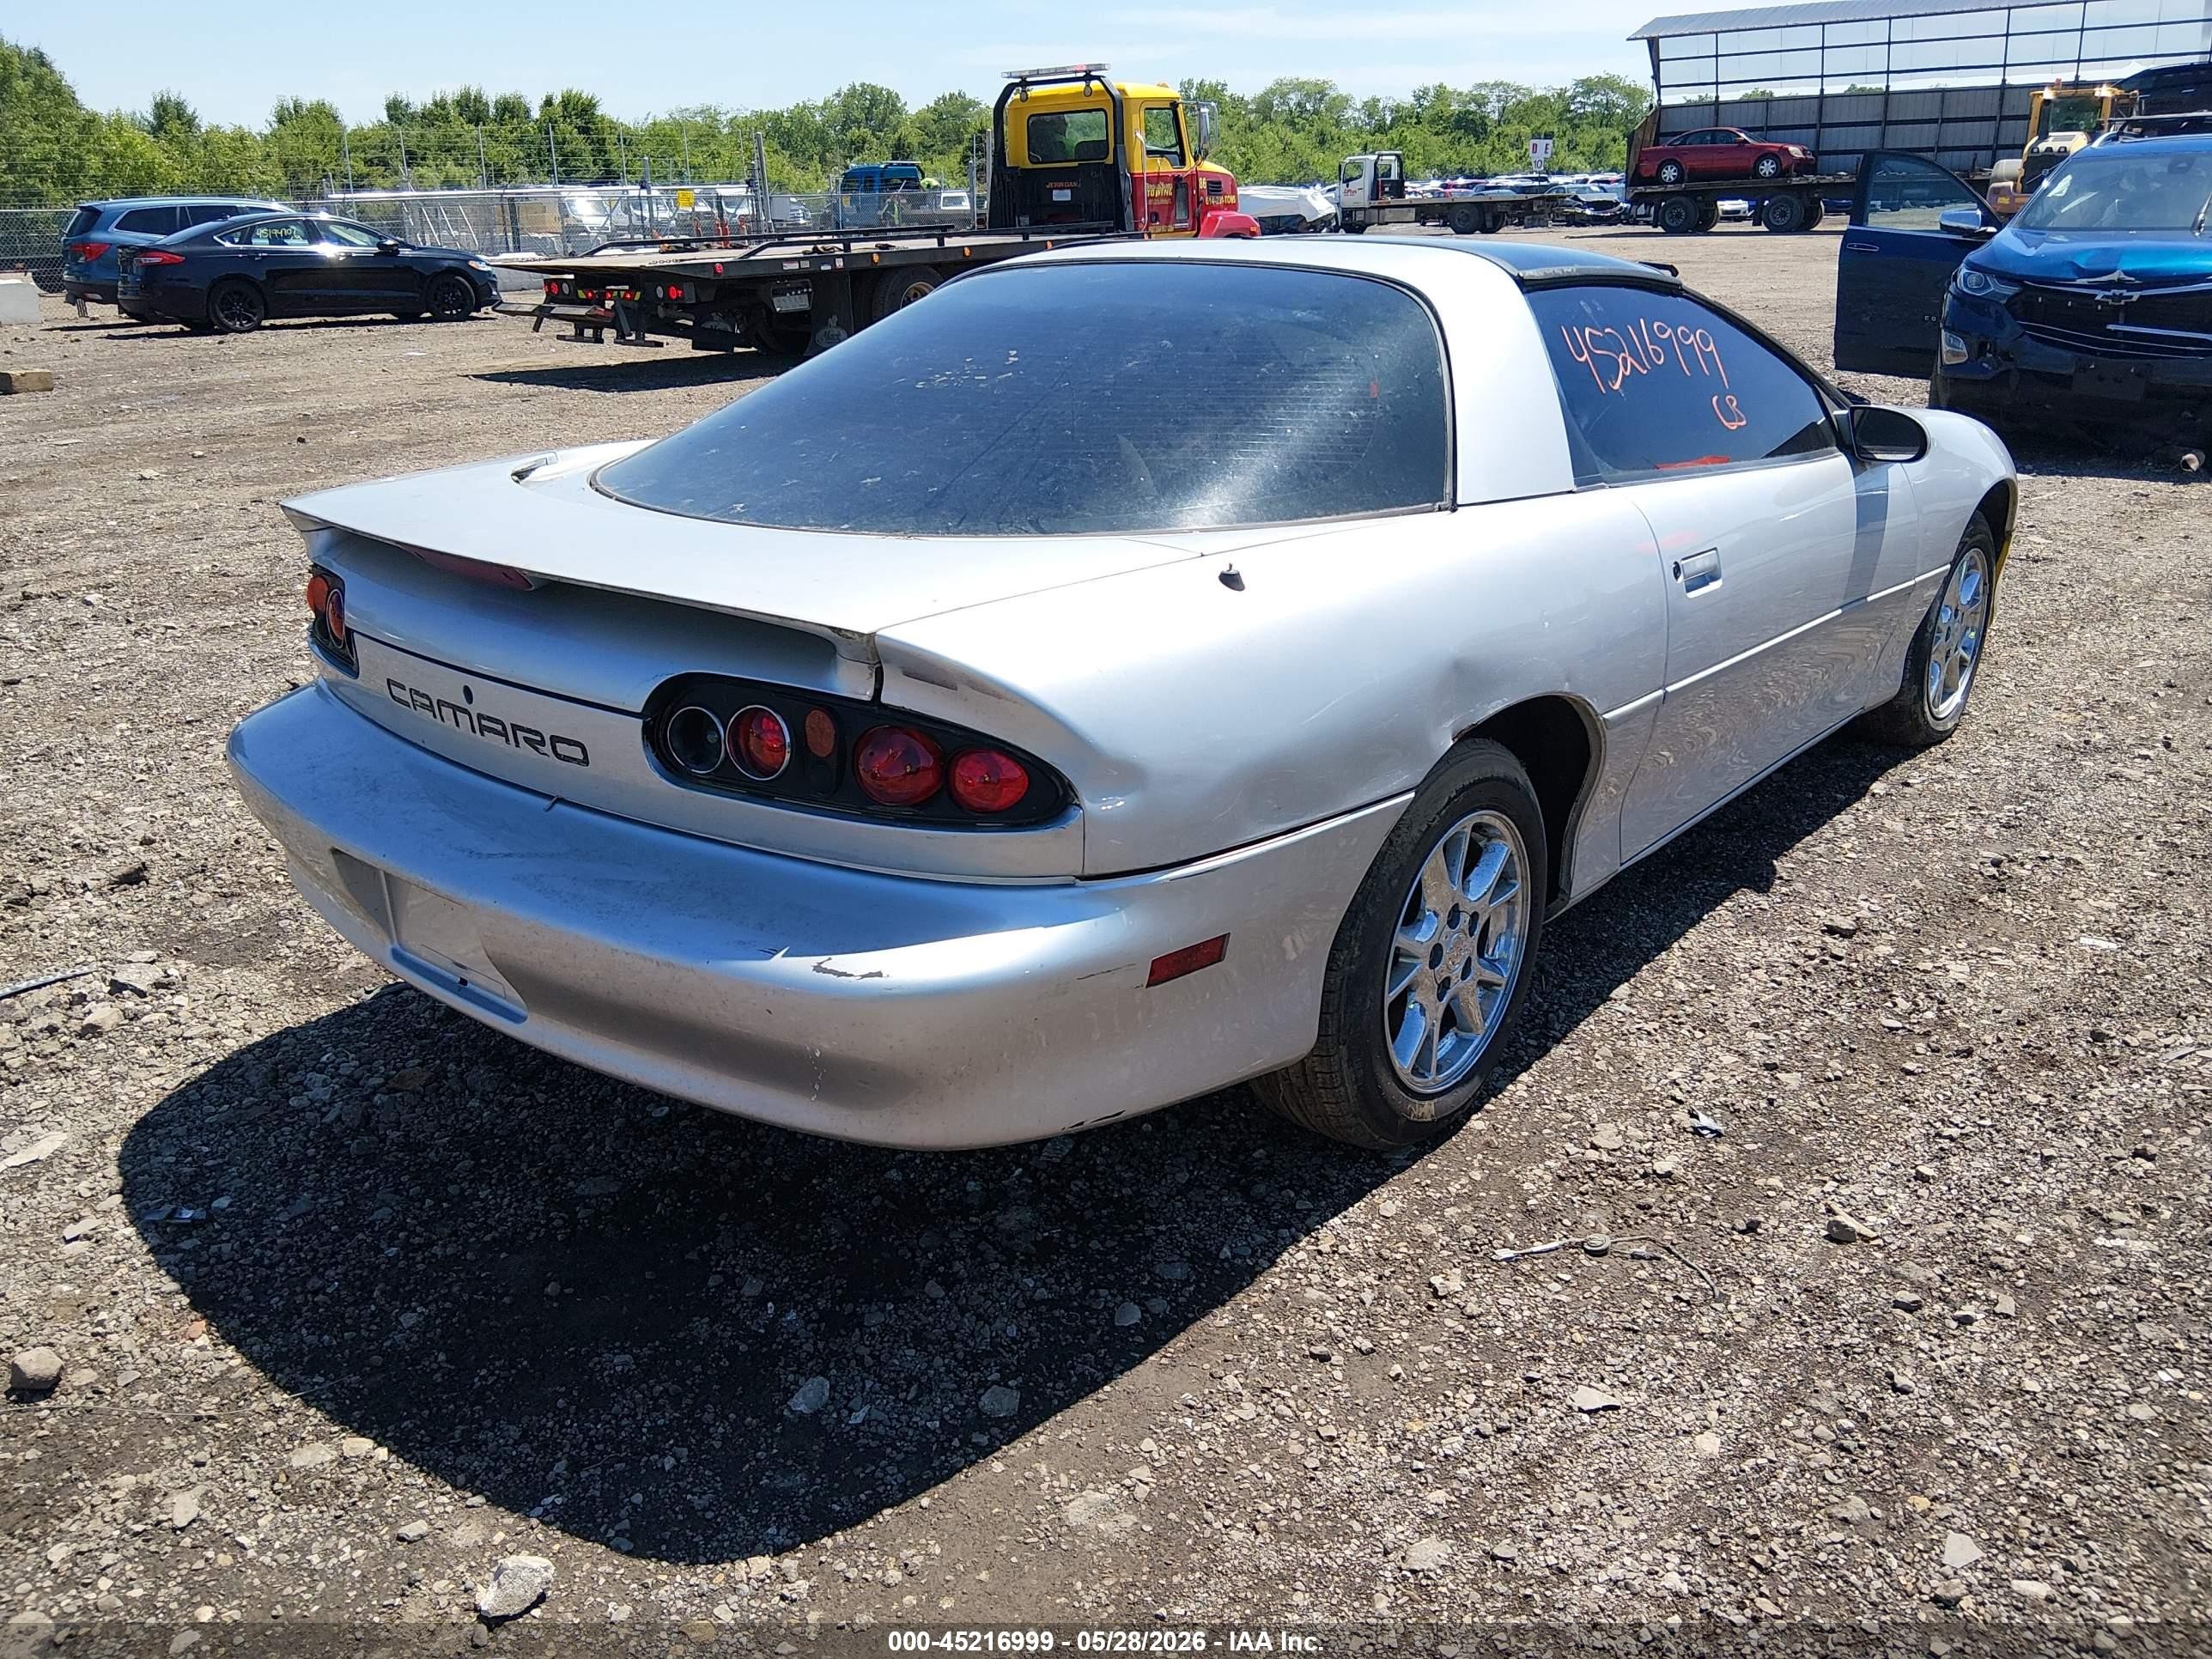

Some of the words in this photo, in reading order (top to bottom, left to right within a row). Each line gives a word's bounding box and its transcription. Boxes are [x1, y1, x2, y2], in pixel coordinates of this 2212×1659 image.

[1534, 159, 1543, 169] 10
[1561, 318, 1729, 394] 45216999
[386, 678, 590, 767] CAMARO
